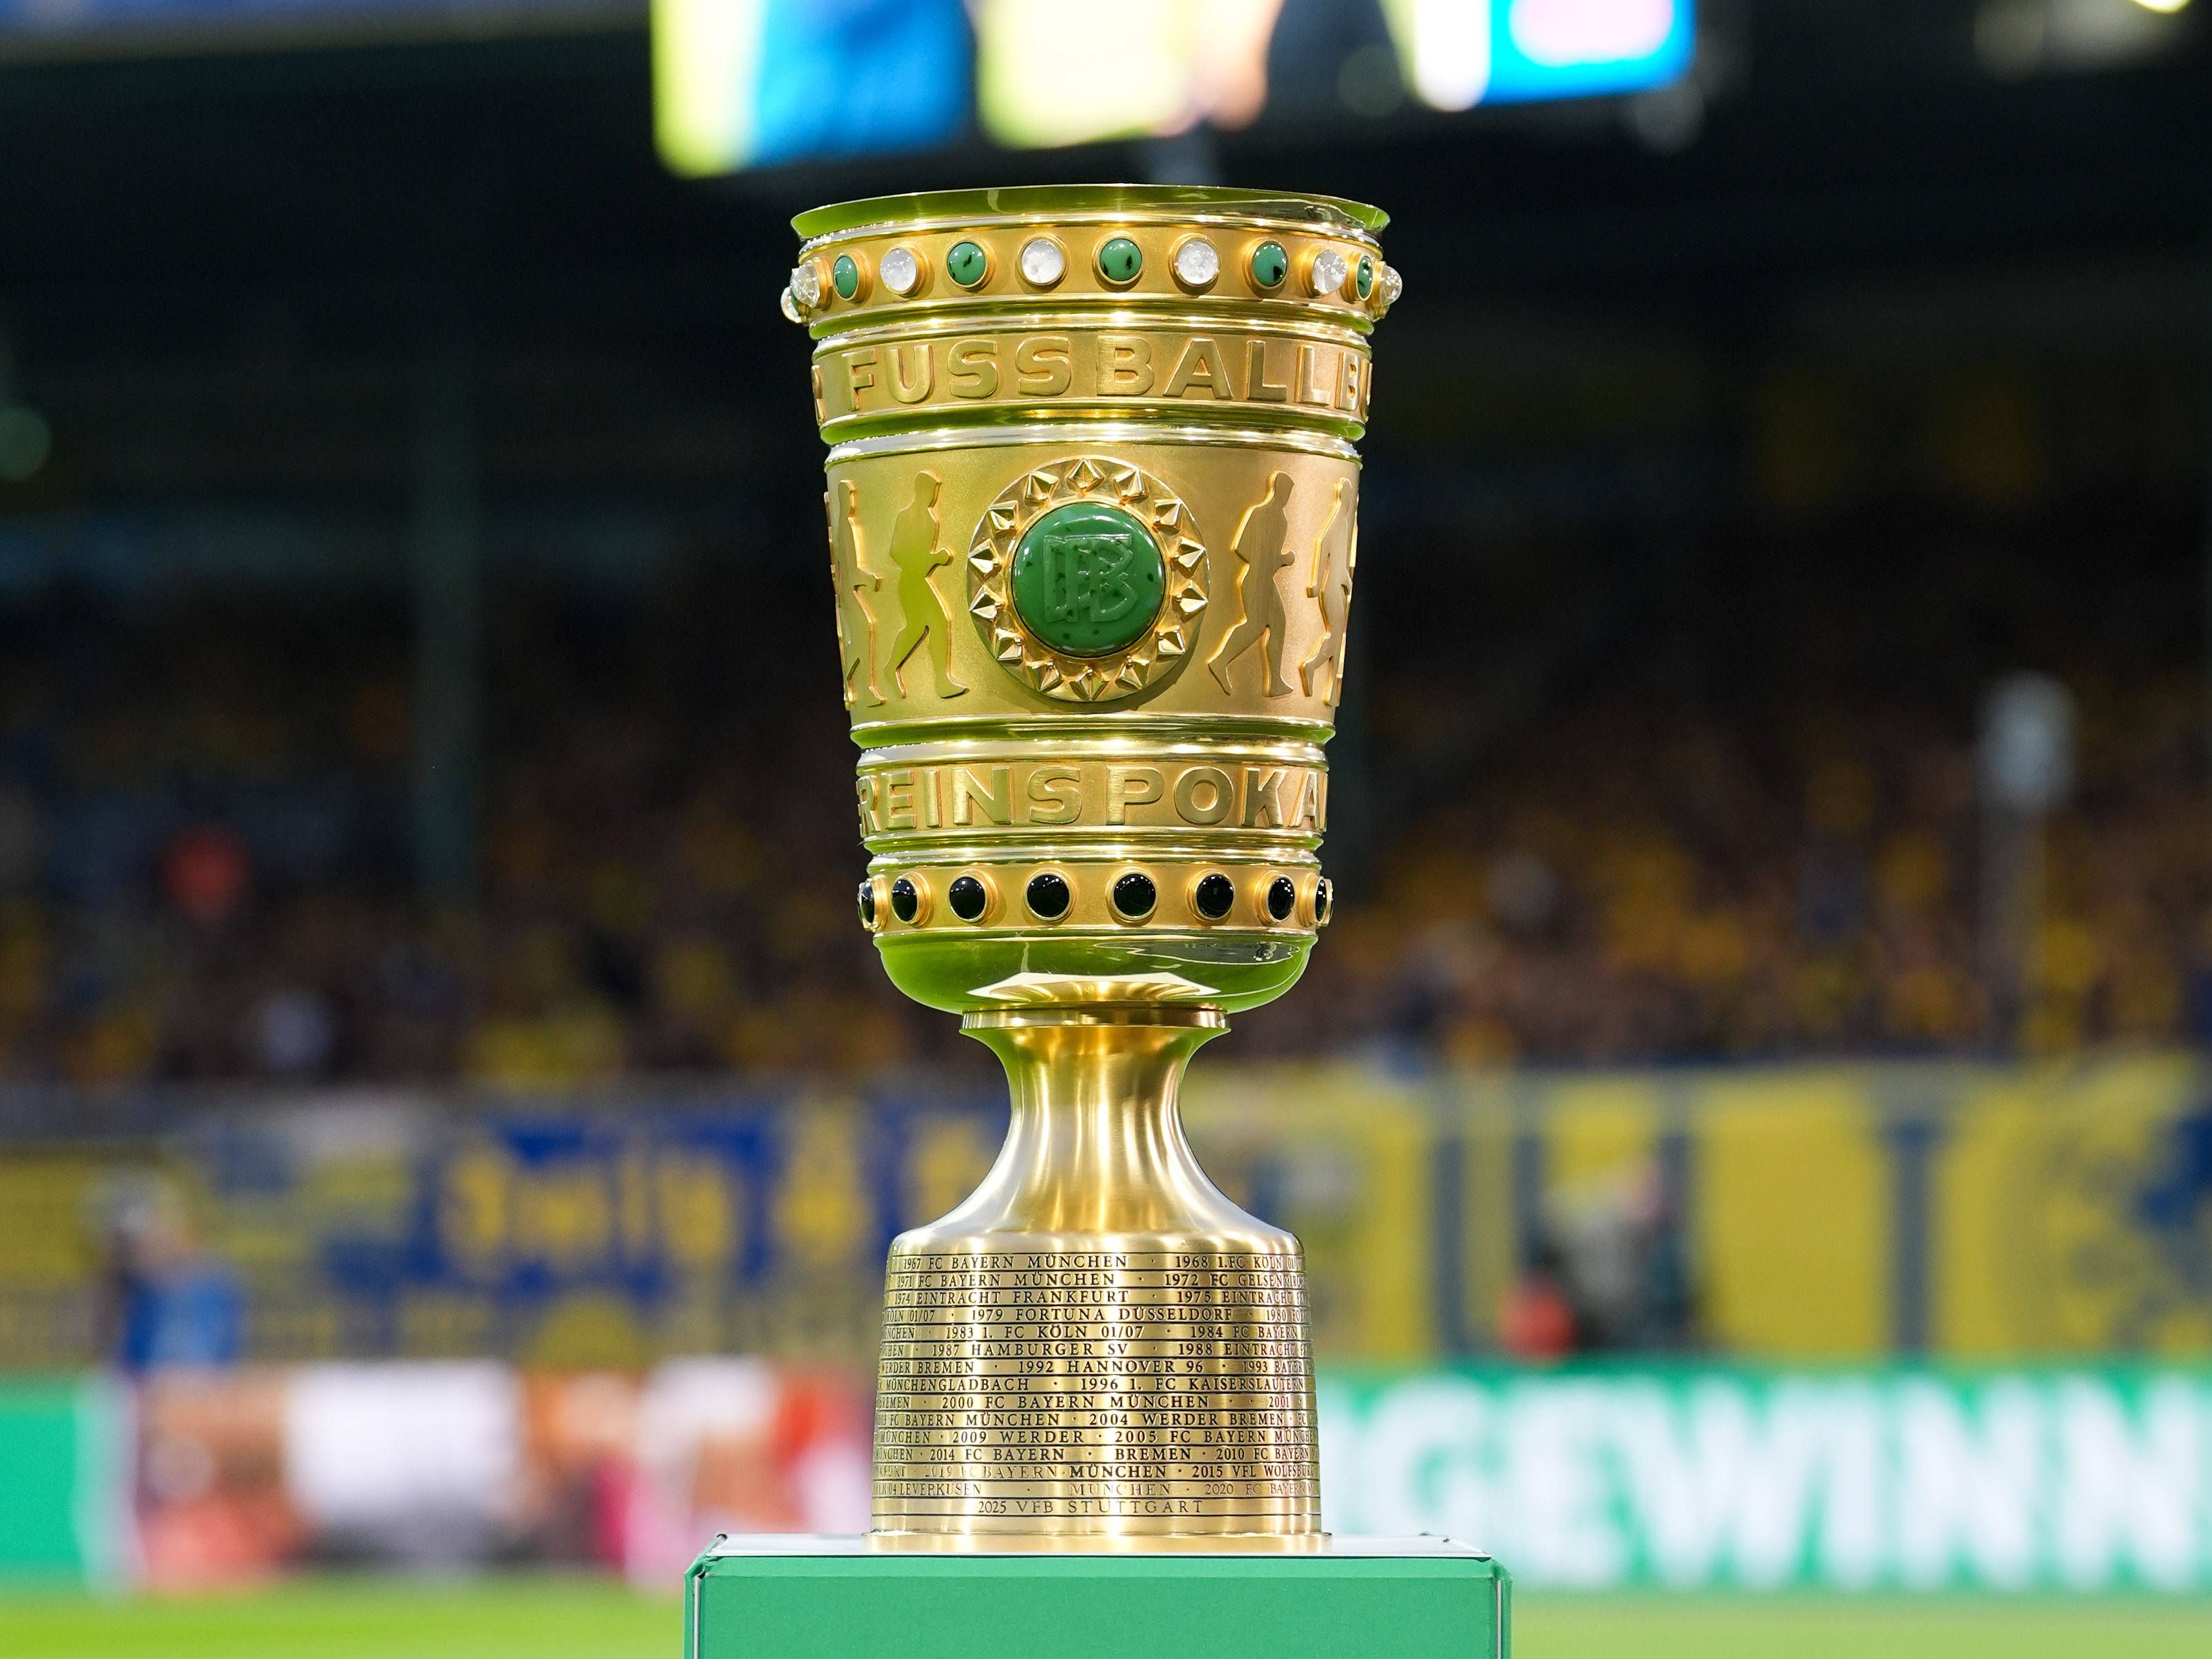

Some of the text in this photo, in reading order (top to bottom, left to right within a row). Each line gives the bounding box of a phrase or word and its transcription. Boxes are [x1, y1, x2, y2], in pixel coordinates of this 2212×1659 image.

[856, 765, 1328, 838] REINSPOKA
[904, 1258, 922, 1270] 1967
[928, 1257, 942, 1270] FC
[951, 1256, 1014, 1268] BAYERN
[1027, 1253, 1127, 1268] MÜNCHEN
[1176, 1256, 1209, 1268] 1968
[1253, 1255, 1282, 1269] KÖLN
[897, 1276, 912, 1288] 1971
[918, 1275, 932, 1288] FC
[940, 1274, 1001, 1287] BAYERN
[1014, 1271, 1115, 1286] MÜNCHEN
[1165, 1274, 1200, 1286] 1972
[1211, 1274, 1229, 1286] FC
[894, 1293, 911, 1305] 1974
[916, 1291, 1001, 1304] EINTRACHT
[1013, 1291, 1129, 1303] FRANKFURT
[1177, 1291, 1211, 1303] 1975
[1222, 1291, 1293, 1303] EINTRACHT
[909, 1310, 935, 1322] 01/07
[971, 1309, 1003, 1321] 1979
[1015, 1309, 1105, 1321] FORTUNA
[1118, 1306, 1232, 1321] DÜSSELDORF
[1266, 1309, 1287, 1321] 1980
[946, 1326, 973, 1339] 1983
[1004, 1326, 1025, 1339] FC
[1037, 1324, 1087, 1339] KÖLN
[1101, 1326, 1145, 1338] 01/07
[1190, 1326, 1223, 1338] 1984
[1232, 1326, 1250, 1338] FC
[1258, 1326, 1298, 1339] BAYERN
[933, 1344, 960, 1357] 1987
[971, 1343, 1094, 1356] HAMBURGER
[1107, 1344, 1129, 1355] SV
[1179, 1344, 1212, 1355] 1988
[1224, 1344, 1296, 1355] EINTRACHT
[917, 1361, 974, 1374] BREMEN
[1019, 1360, 1054, 1373] 1992
[1067, 1360, 1176, 1373] HANNOVER
[1186, 1360, 1203, 1373] 96
[1243, 1360, 1268, 1373] 1993
[1274, 1360, 1303, 1373] BAYER
[885, 1378, 1030, 1391] MÖNCHENGLADBACH
[1081, 1378, 1118, 1390] 1996
[1155, 1378, 1176, 1390] FC
[1189, 1378, 1304, 1390] KAISERSLAUTERN
[942, 1397, 974, 1409] 2000
[985, 1396, 1005, 1408] FC
[1017, 1396, 1094, 1408] BAYERN
[1110, 1393, 1209, 1408] MÜNCHEN
[1269, 1396, 1289, 1408] 2001
[890, 1414, 899, 1426] FC
[905, 1414, 954, 1426] BAYERN
[966, 1411, 1060, 1426] MÜNCHEN
[1089, 1413, 1129, 1425] 2004
[1141, 1413, 1218, 1425] WERDER
[1229, 1413, 1284, 1425] BREMEN
[953, 1431, 987, 1443] 2009
[1000, 1431, 1085, 1443] WERDER
[1115, 1431, 1157, 1443] 2005
[1170, 1431, 1191, 1443] FC
[1204, 1431, 1267, 1443] BAYERN
[930, 1448, 955, 1460] 2014
[965, 1448, 983, 1460] FC
[993, 1448, 1065, 1460] BAYERN
[1116, 1448, 1191, 1460] BREMEN
[1216, 1448, 1245, 1460] 2010
[1254, 1448, 1269, 1460] FC
[1275, 1448, 1309, 1460] BAYERN
[924, 1466, 953, 1477] 2019
[983, 1466, 1058, 1477] BAYERN
[1069, 1463, 1167, 1478] MÜNCHEN
[1192, 1466, 1223, 1477] 2015
[1232, 1466, 1256, 1477] VFL
[900, 1484, 982, 1495] LEVERKUSEN
[1205, 1484, 1234, 1495] 2020
[1245, 1484, 1262, 1495] FC
[1270, 1484, 1306, 1495] BAYERN
[978, 1501, 1203, 1513] 2025 VFB STUTTGART
